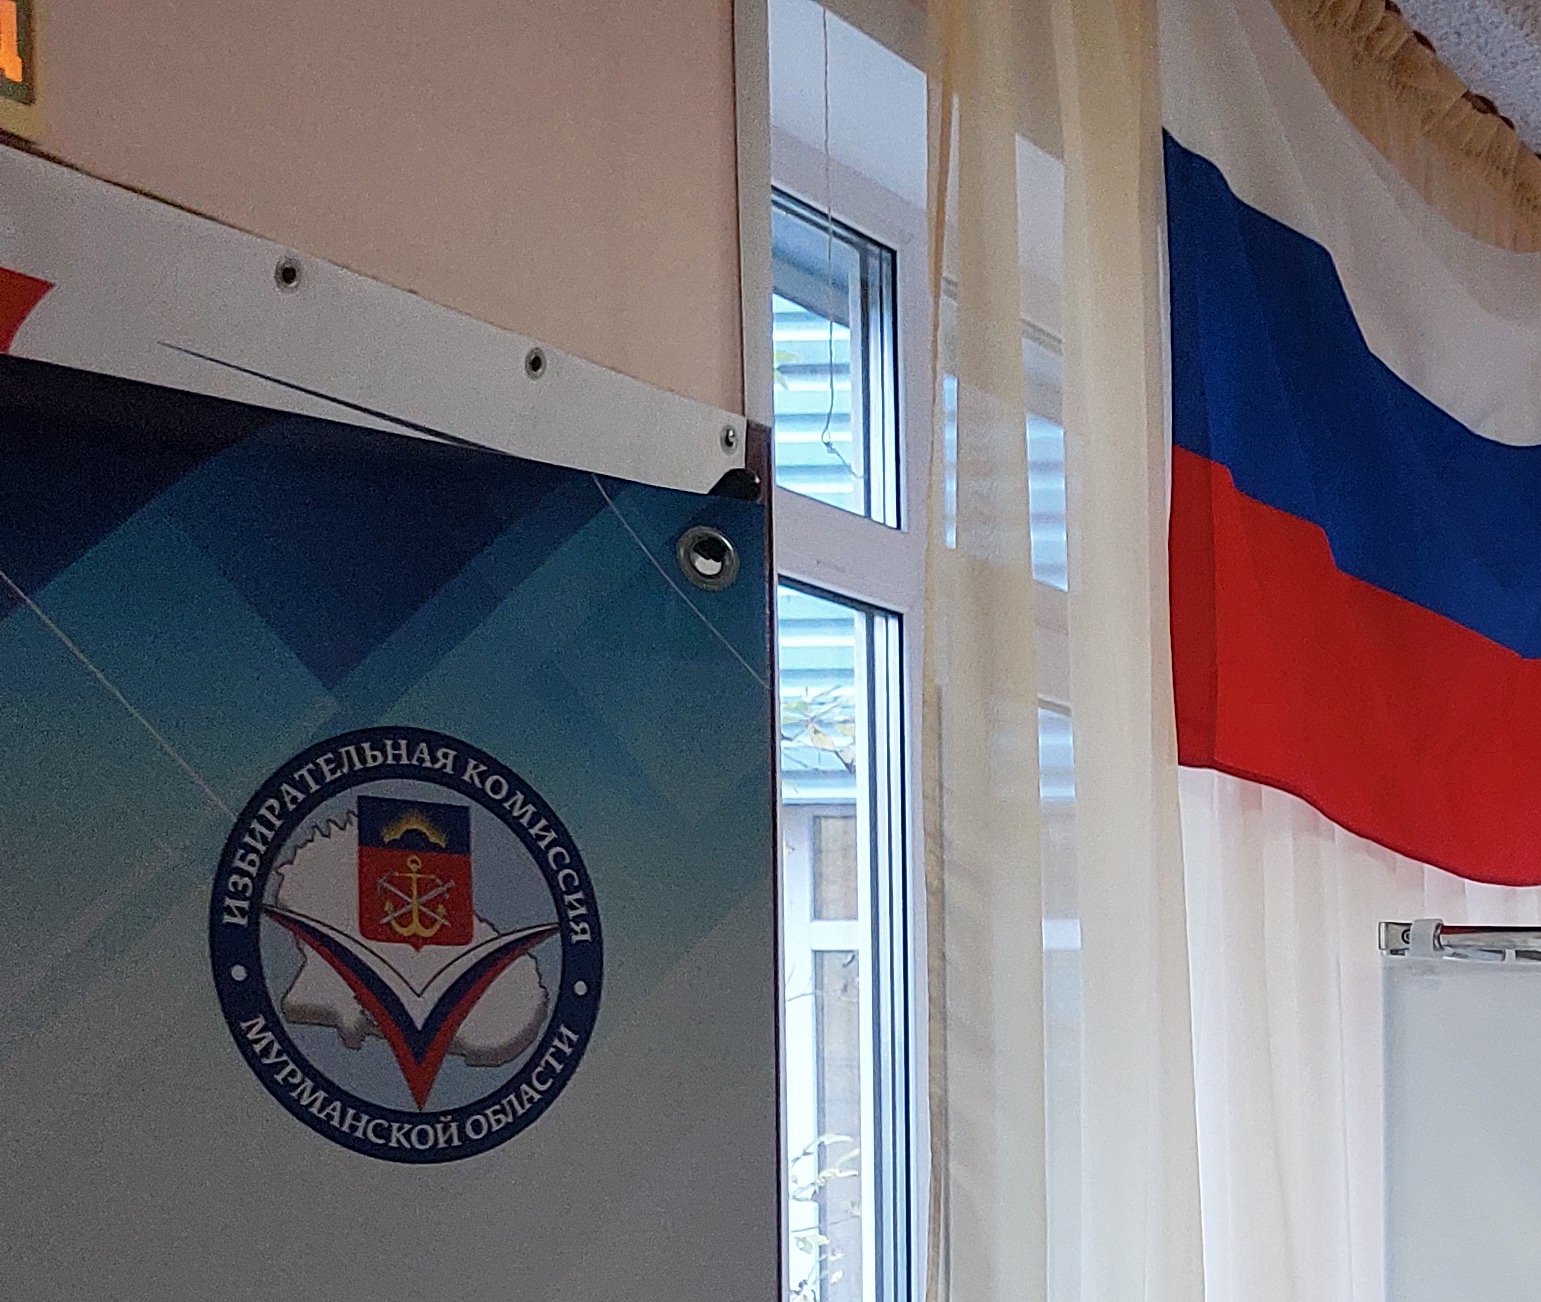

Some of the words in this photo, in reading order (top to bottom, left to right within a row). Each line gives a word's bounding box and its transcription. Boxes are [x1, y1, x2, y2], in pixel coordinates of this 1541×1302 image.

[222, 739, 458, 926] ИЗБИРАТЕЛЬНАЯ
[463, 758, 592, 943] КОМИССИЯ
[240, 1014, 462, 1150] МУРМАНСКОЙ
[465, 1026, 580, 1140] ОБЛАСТИ
